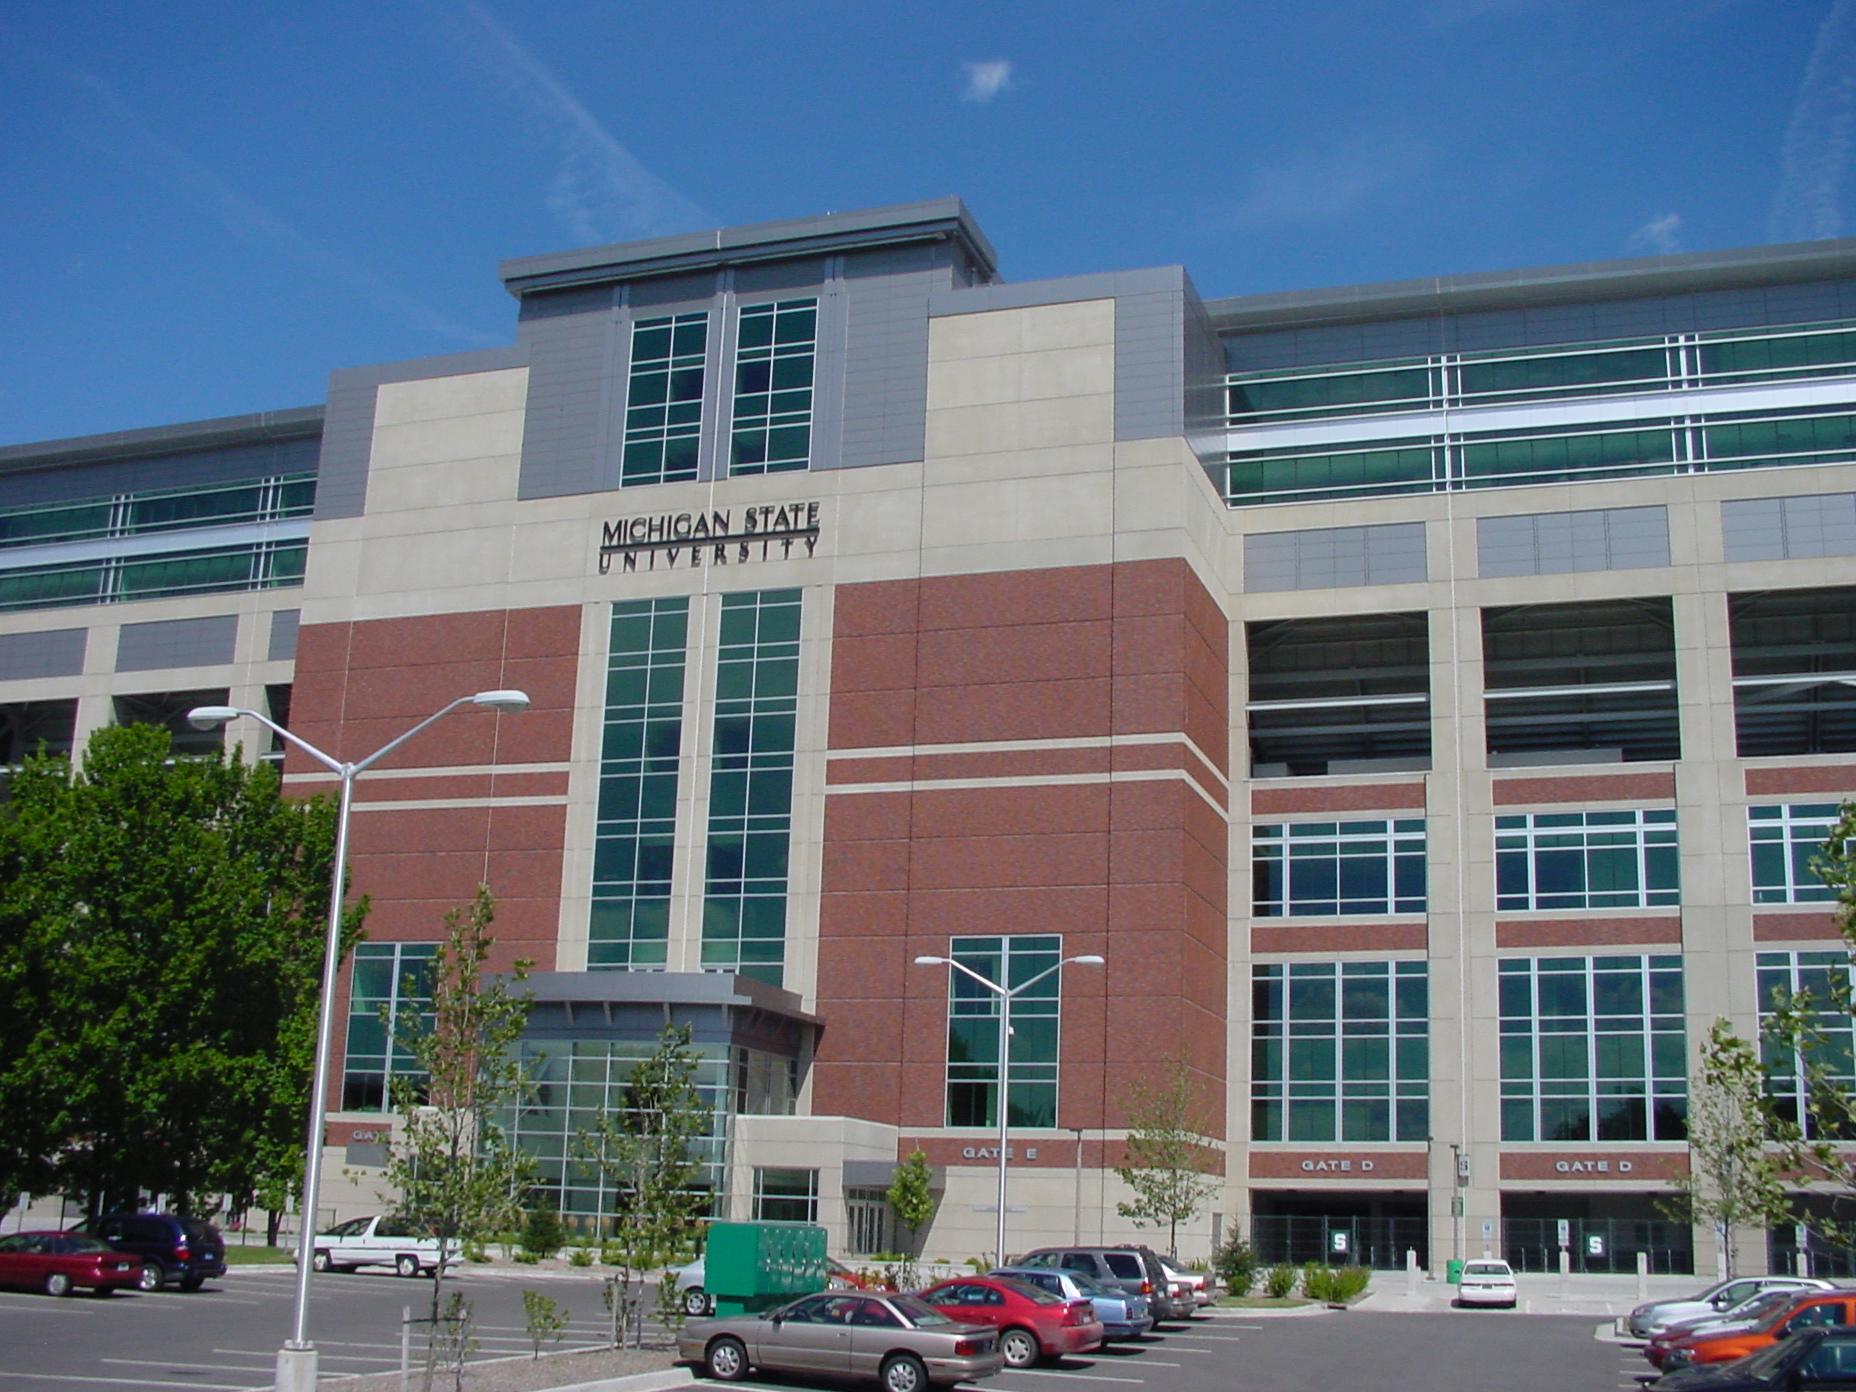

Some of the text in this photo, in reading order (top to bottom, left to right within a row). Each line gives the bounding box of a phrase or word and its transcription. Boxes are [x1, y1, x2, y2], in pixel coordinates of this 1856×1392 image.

[602, 501, 820, 546] MICHIGAN STATE
[598, 536, 818, 575] UNIVERSITY
[1026, 1148, 1037, 1160] E
[1301, 1160, 1374, 1172] GATE D
[1556, 1160, 1632, 1173] GATE D
[1335, 1233, 1346, 1250] S
[1589, 1236, 1602, 1253] S
